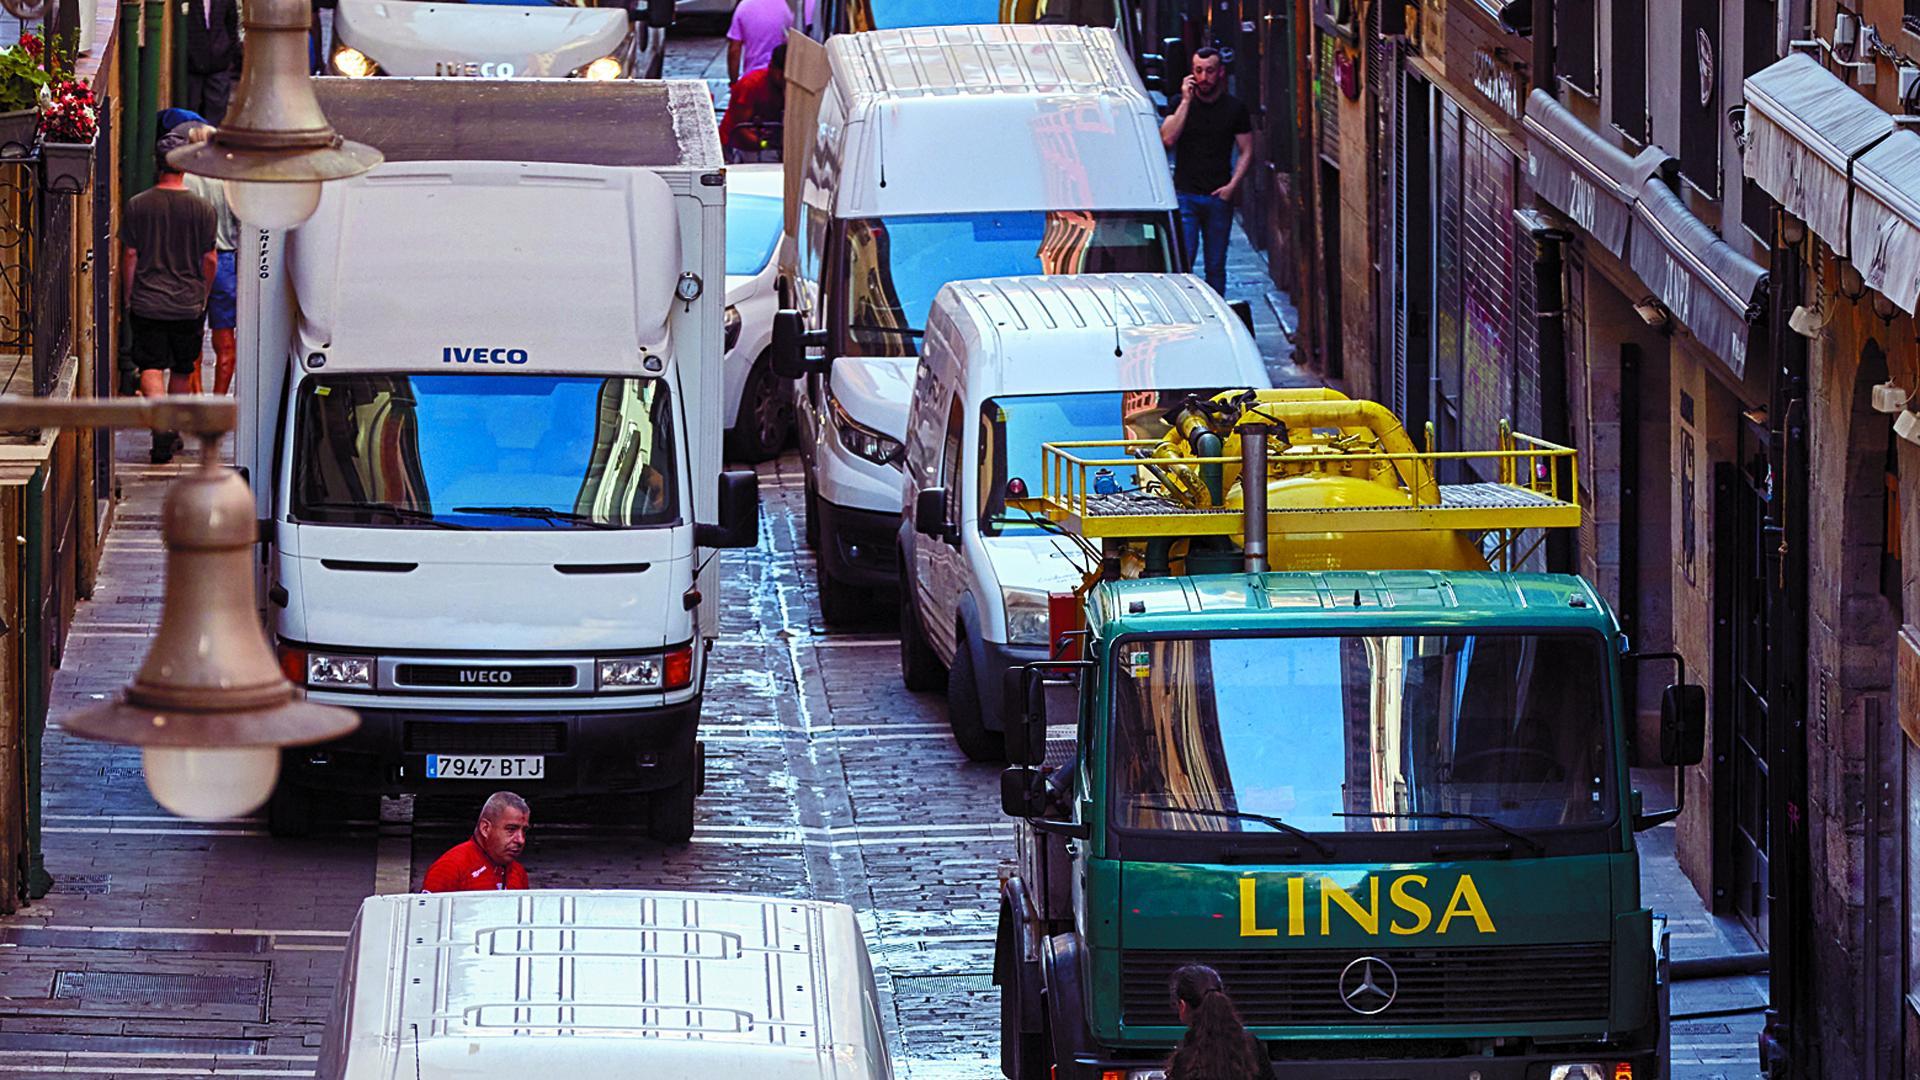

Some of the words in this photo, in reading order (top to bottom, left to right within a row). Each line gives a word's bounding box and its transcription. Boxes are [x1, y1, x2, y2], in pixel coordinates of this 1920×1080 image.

[435, 62, 515, 78] IVECO
[443, 347, 528, 364] IVECO
[460, 670, 512, 683] IVECO
[439, 758, 493, 776] 7947
[500, 758, 540, 776] BTJ
[1239, 874, 1497, 936] LINSA
